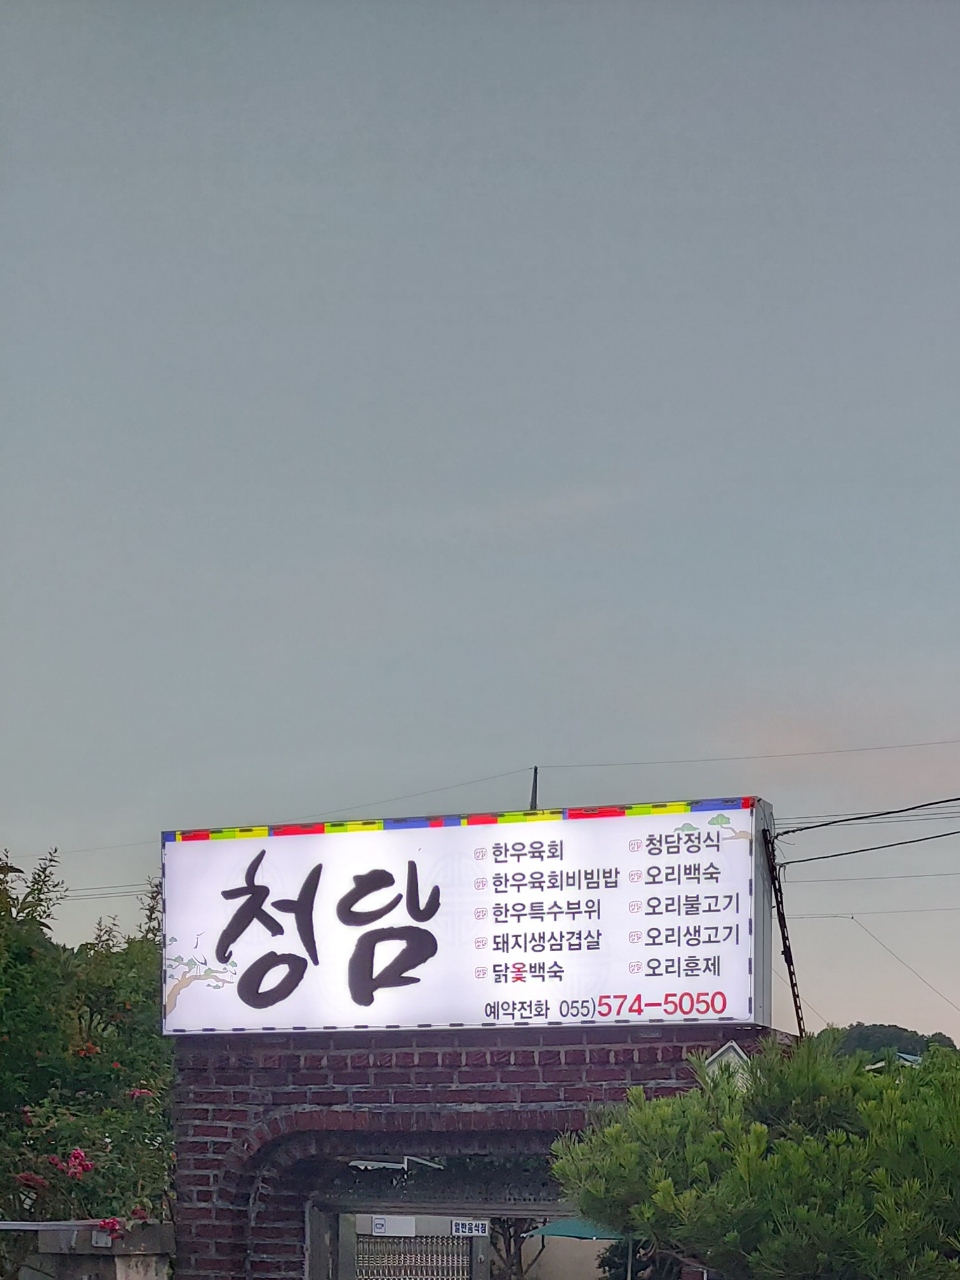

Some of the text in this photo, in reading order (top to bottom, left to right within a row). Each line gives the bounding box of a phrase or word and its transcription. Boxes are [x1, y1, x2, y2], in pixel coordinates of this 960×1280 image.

[492, 839, 564, 864] 한우육회
[645, 830, 721, 856] 청담정식
[492, 867, 620, 894] 한우육회비빔밥
[644, 862, 721, 885] 오리백숙
[492, 898, 601, 924] 한우특수부위
[644, 892, 740, 916] 오리불고기
[215, 848, 442, 1009] 청담
[493, 928, 602, 953] 돼지생삼겹살
[644, 923, 740, 947] 오리생고기
[493, 960, 565, 984] 닭옻백숙
[644, 955, 721, 978] 오리훈제
[485, 999, 550, 1020] 예약전화
[454, 1222, 487, 1234] 일반음식점
